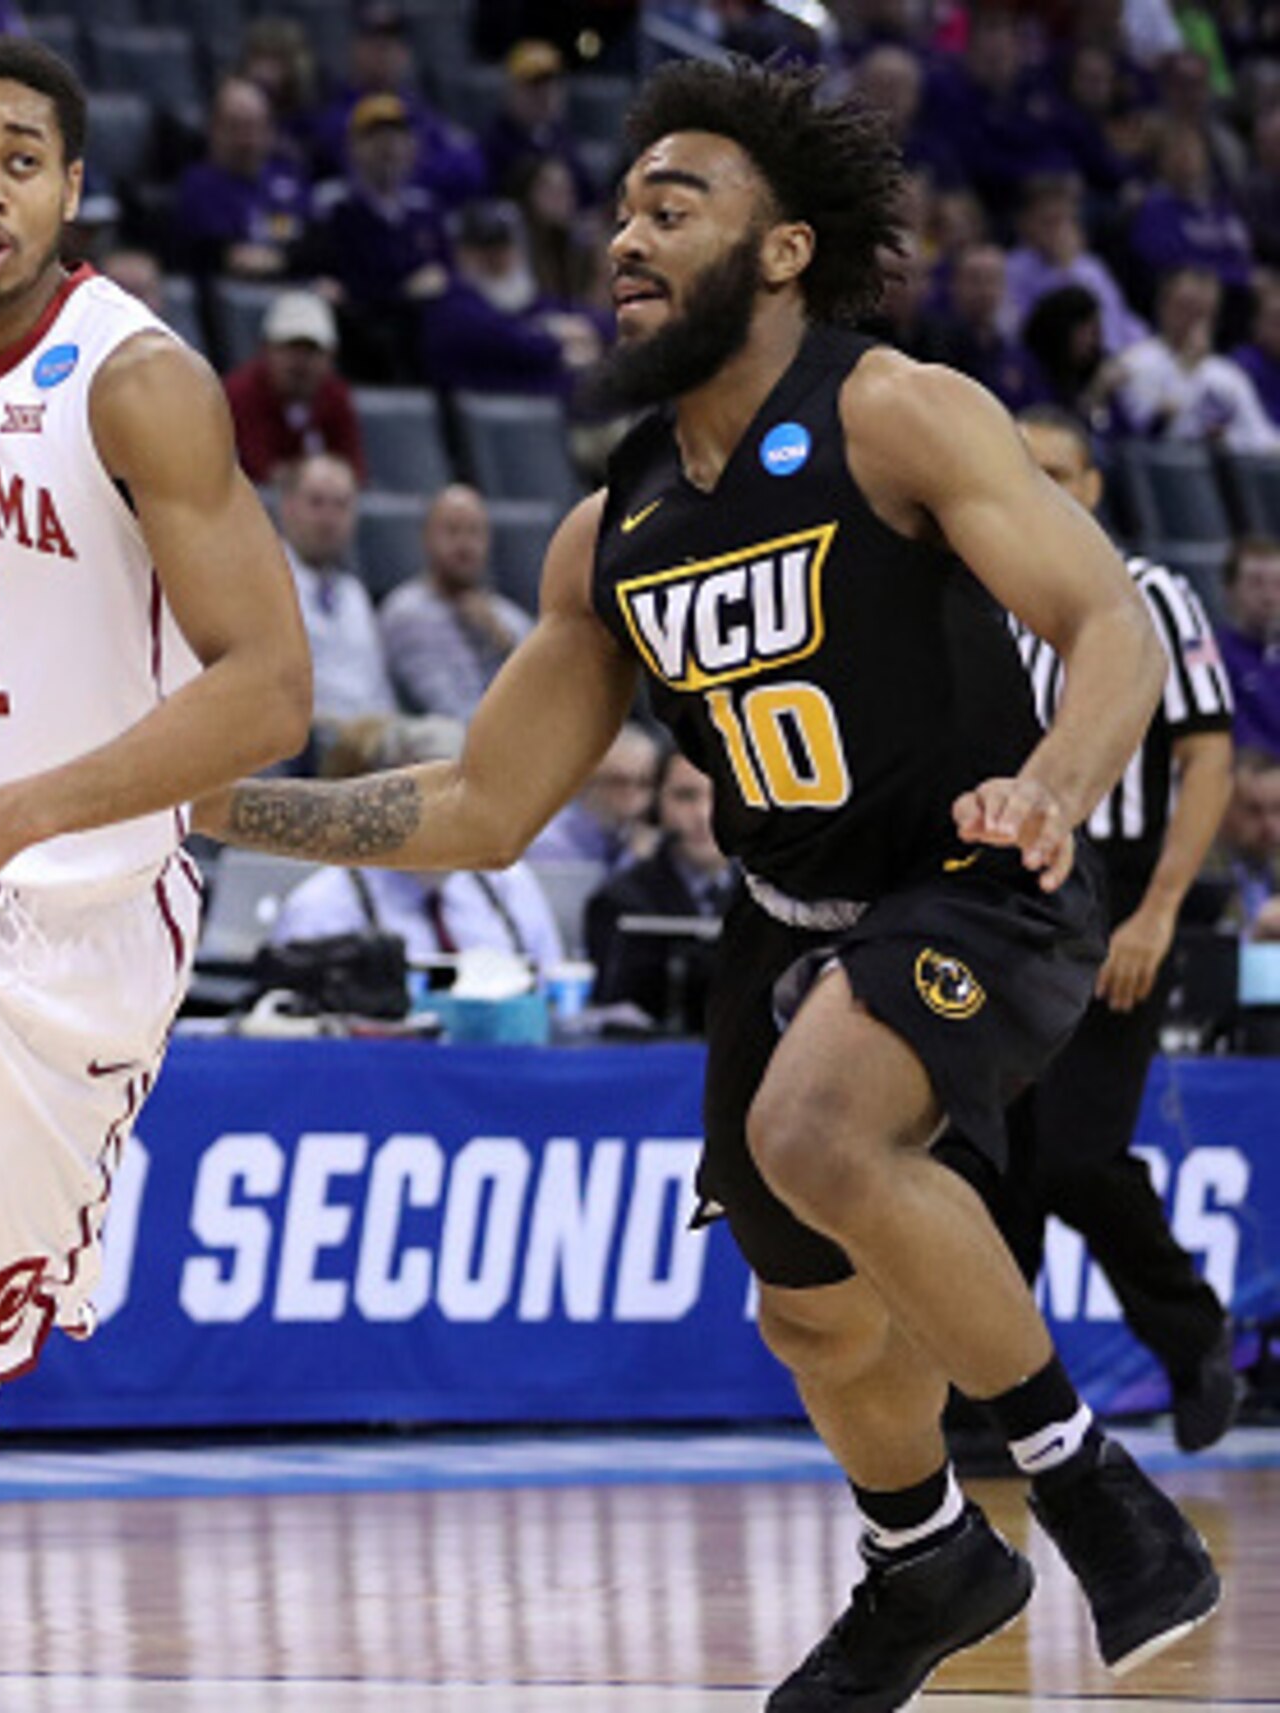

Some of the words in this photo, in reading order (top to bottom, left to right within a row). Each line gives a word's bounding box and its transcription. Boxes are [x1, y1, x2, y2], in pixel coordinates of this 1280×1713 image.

[631, 547, 812, 681] VCU
[703, 681, 852, 811] 10
[178, 1131, 710, 1324] SECOND
